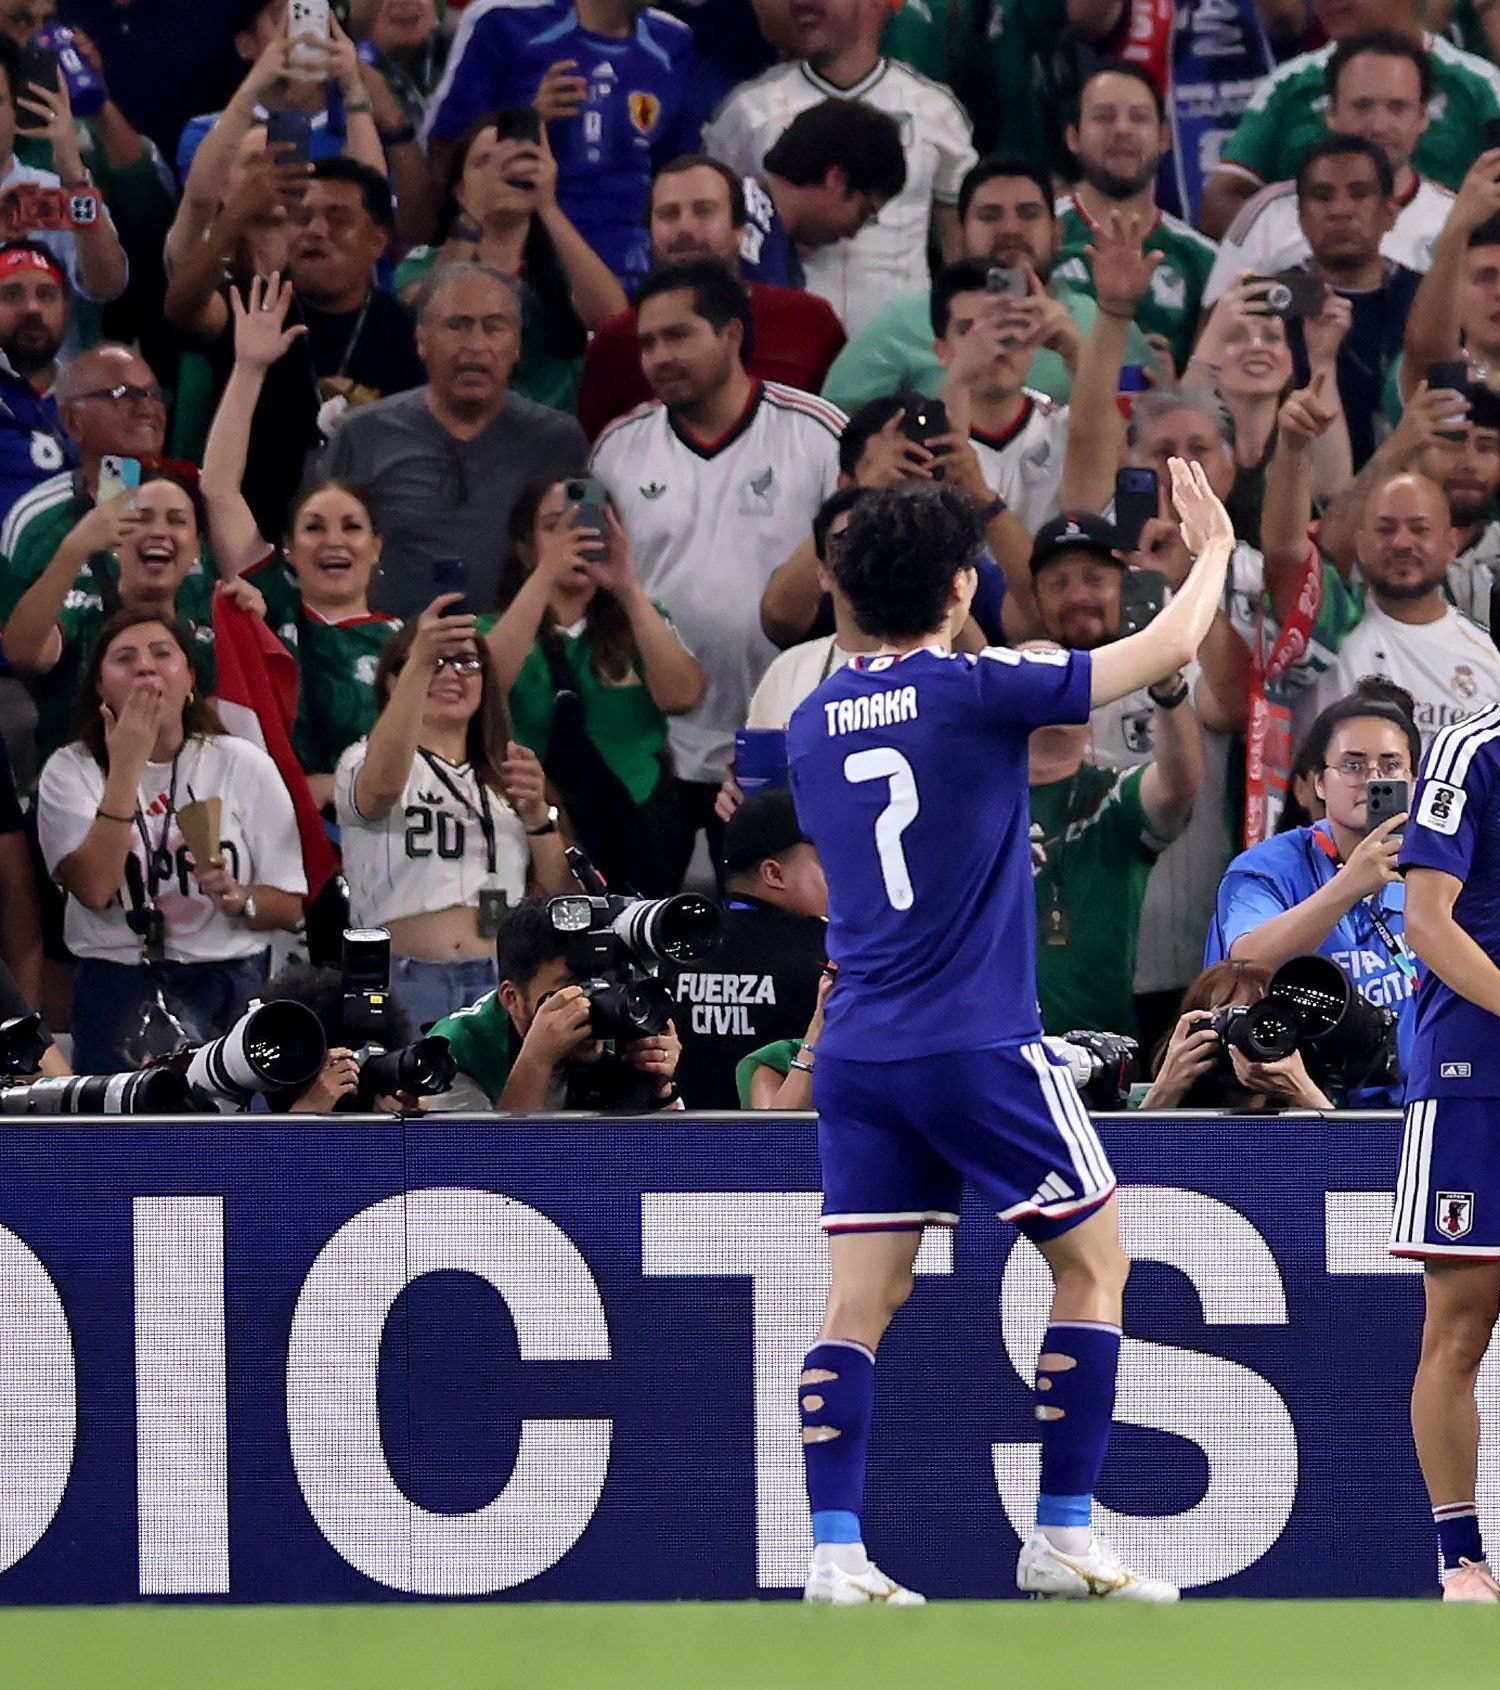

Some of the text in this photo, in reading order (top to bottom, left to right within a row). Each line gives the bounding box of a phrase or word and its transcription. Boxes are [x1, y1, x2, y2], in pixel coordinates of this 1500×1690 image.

[824, 685, 919, 737] TANAKA
[404, 804, 465, 859] 20
[843, 747, 920, 912] 7
[676, 972, 777, 1004] FUERZA
[691, 1004, 756, 1036] CIVIL
